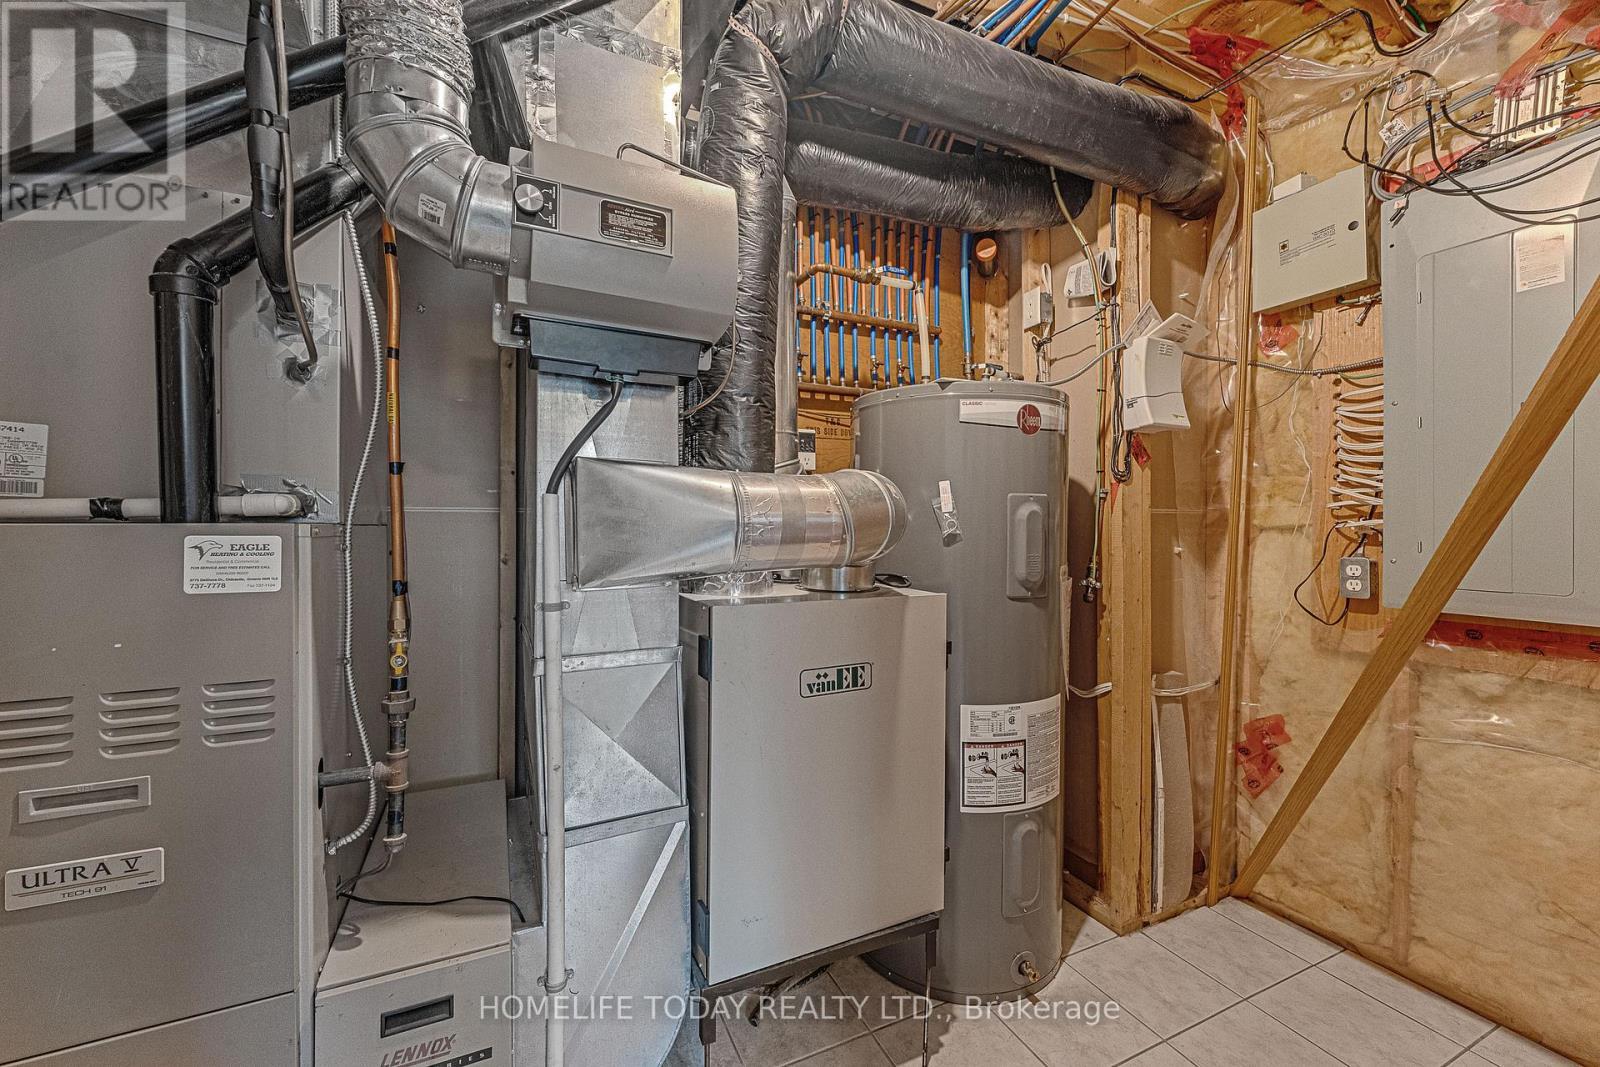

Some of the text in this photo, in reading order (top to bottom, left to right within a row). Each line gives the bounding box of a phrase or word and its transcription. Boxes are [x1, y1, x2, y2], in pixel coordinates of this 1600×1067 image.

[1020, 403, 1041, 431] Rheem
[823, 427, 838, 436] SIDE
[229, 543, 271, 552] EAGLE
[20, 855, 143, 890] ULTRA V
[61, 887, 92, 899] TECH
[381, 1033, 457, 1067] LENNOX
